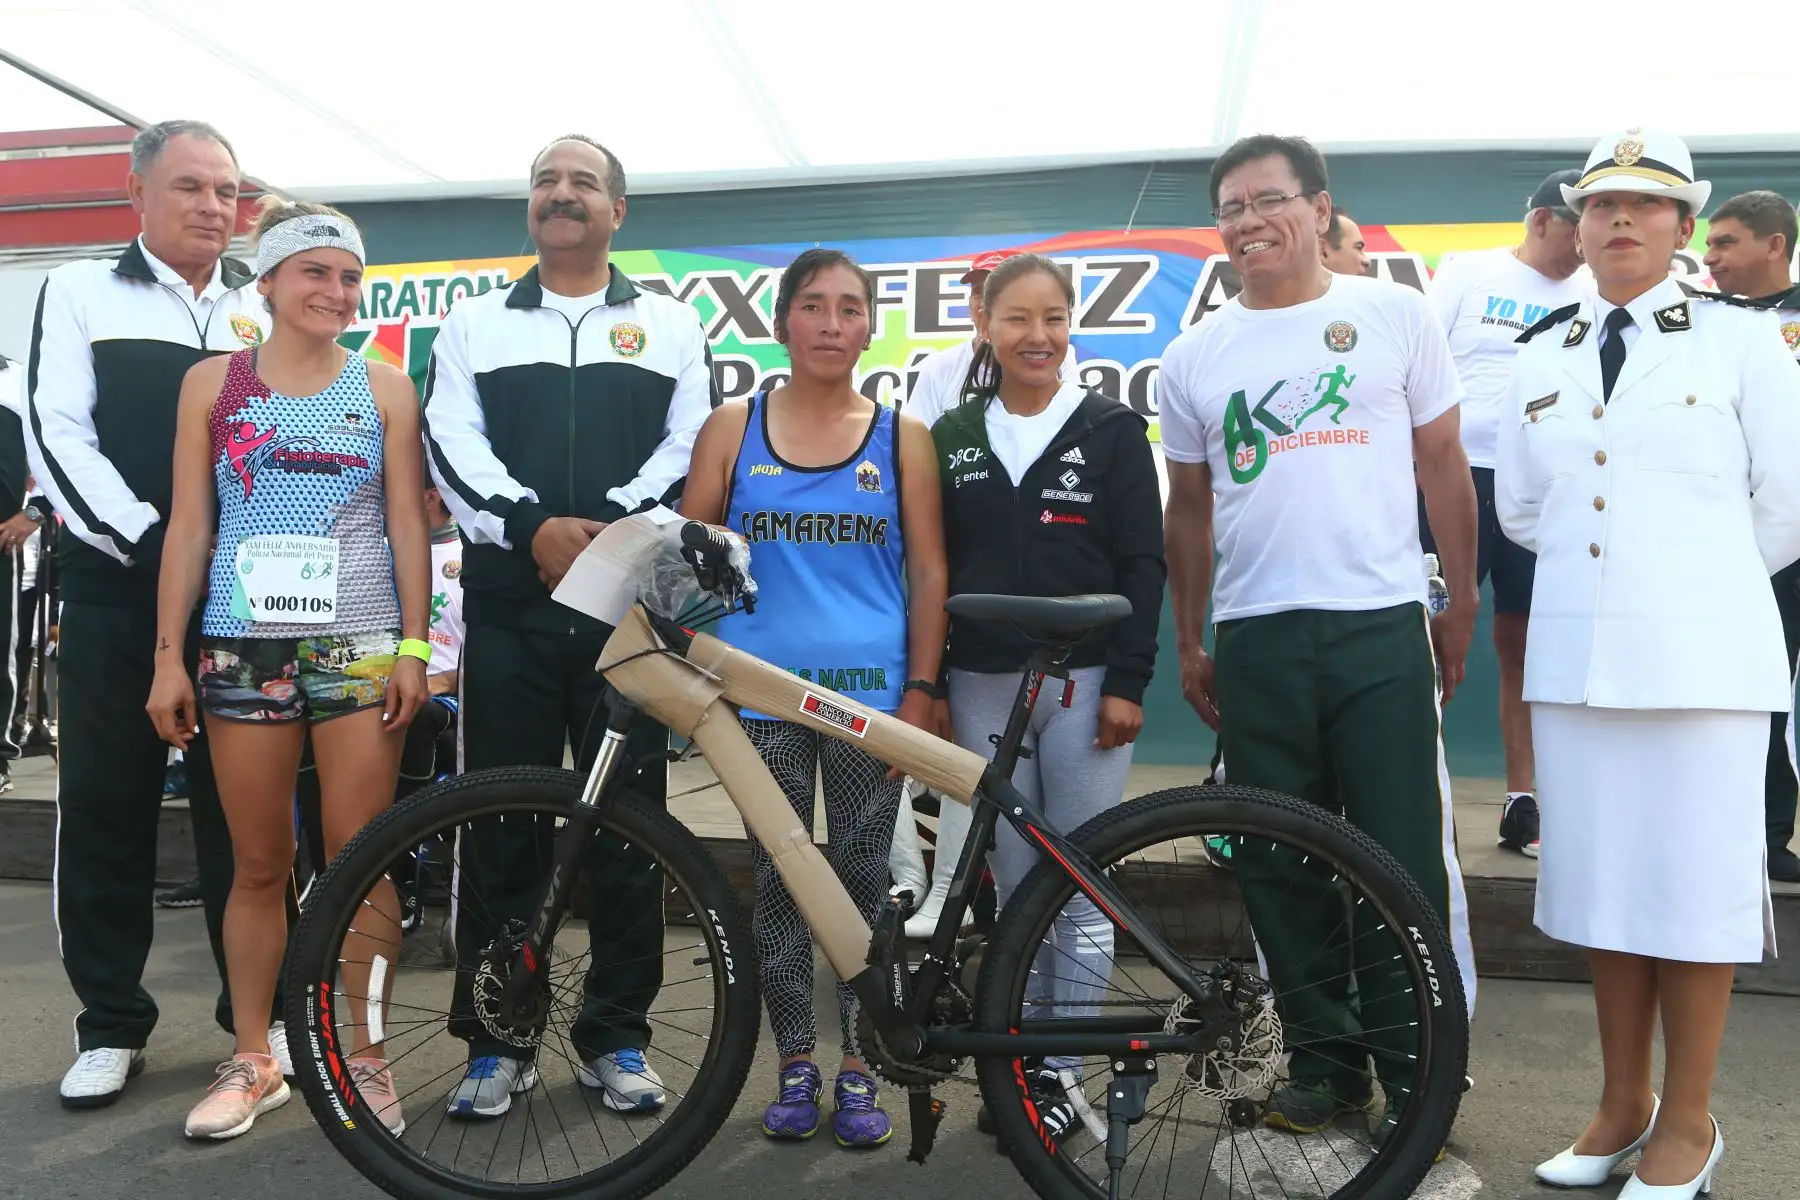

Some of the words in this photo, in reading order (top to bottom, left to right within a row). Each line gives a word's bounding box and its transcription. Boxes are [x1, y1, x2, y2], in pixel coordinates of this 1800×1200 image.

[1485, 296, 1517, 318] YO
[1480, 316, 1496, 325] SIN
[1268, 429, 1370, 455] DICIEMBRE
[275, 448, 369, 468] Fisioterapia
[1059, 456, 1086, 466] adidas
[1235, 447, 1256, 468] DE
[749, 463, 783, 476] JAUJA
[963, 469, 989, 482] entel
[741, 511, 888, 547] CAMARENA
[263, 540, 283, 549] FELIZ
[285, 541, 337, 553] ANIVERSARIO
[271, 550, 302, 559] Nacional
[304, 551, 315, 559] del
[264, 595, 333, 612] 000108
[818, 668, 887, 692] NATUR
[816, 708, 852, 727] COMERCIO
[819, 702, 843, 717] BANCO
[844, 711, 854, 722] DE
[707, 908, 736, 985] KENDA
[1408, 926, 1443, 1007] KENDA
[320, 981, 334, 1049] JAFI
[308, 1030, 322, 1059] EIGHT
[316, 1061, 334, 1091] BLOCK
[328, 1091, 350, 1122] SMALL
